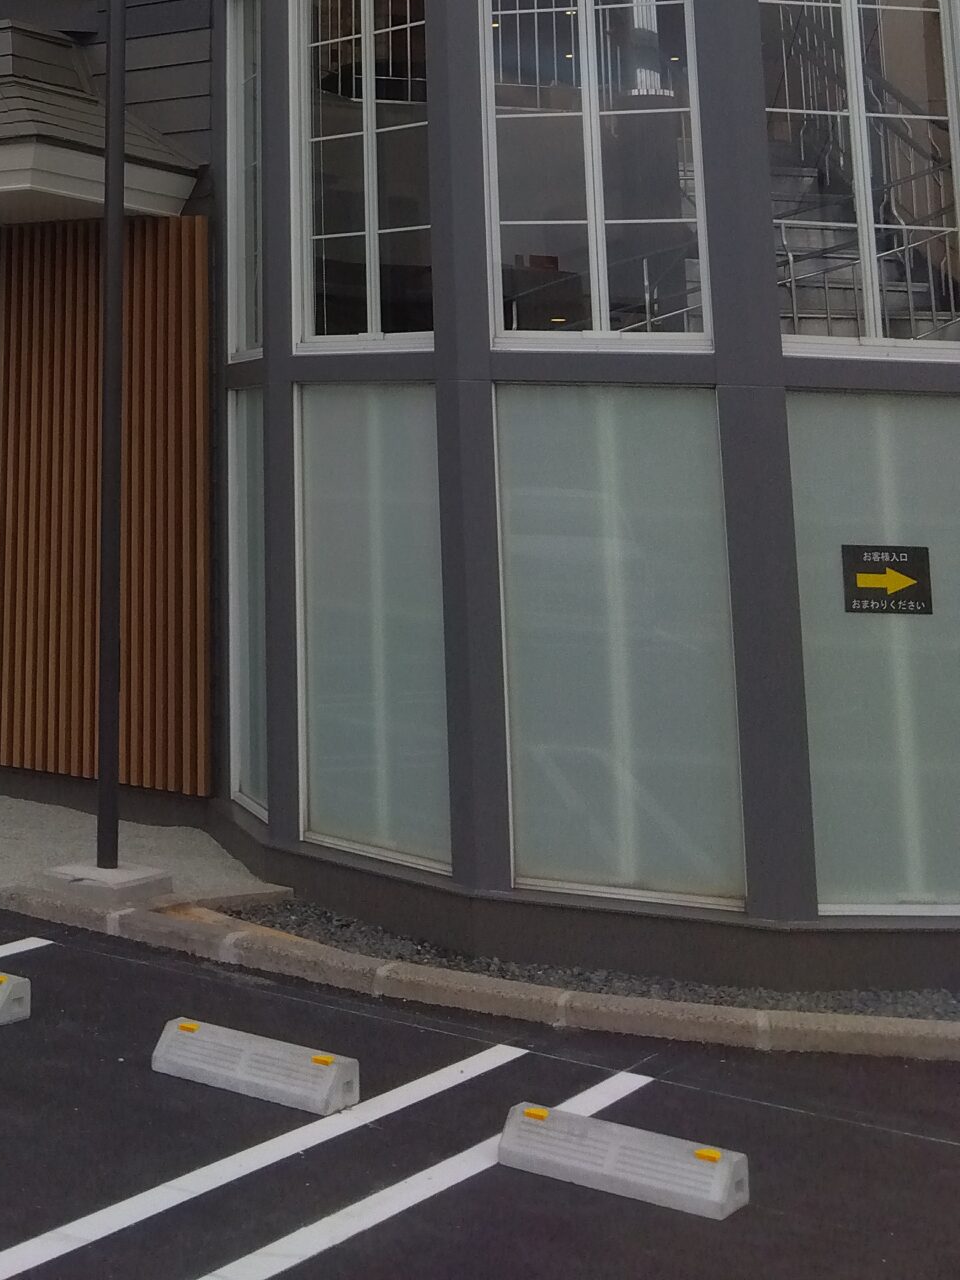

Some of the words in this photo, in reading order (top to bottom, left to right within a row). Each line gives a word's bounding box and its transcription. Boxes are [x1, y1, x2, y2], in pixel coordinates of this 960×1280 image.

[862, 551, 908, 562] お客様入口
[851, 599, 926, 610] おまわりください
